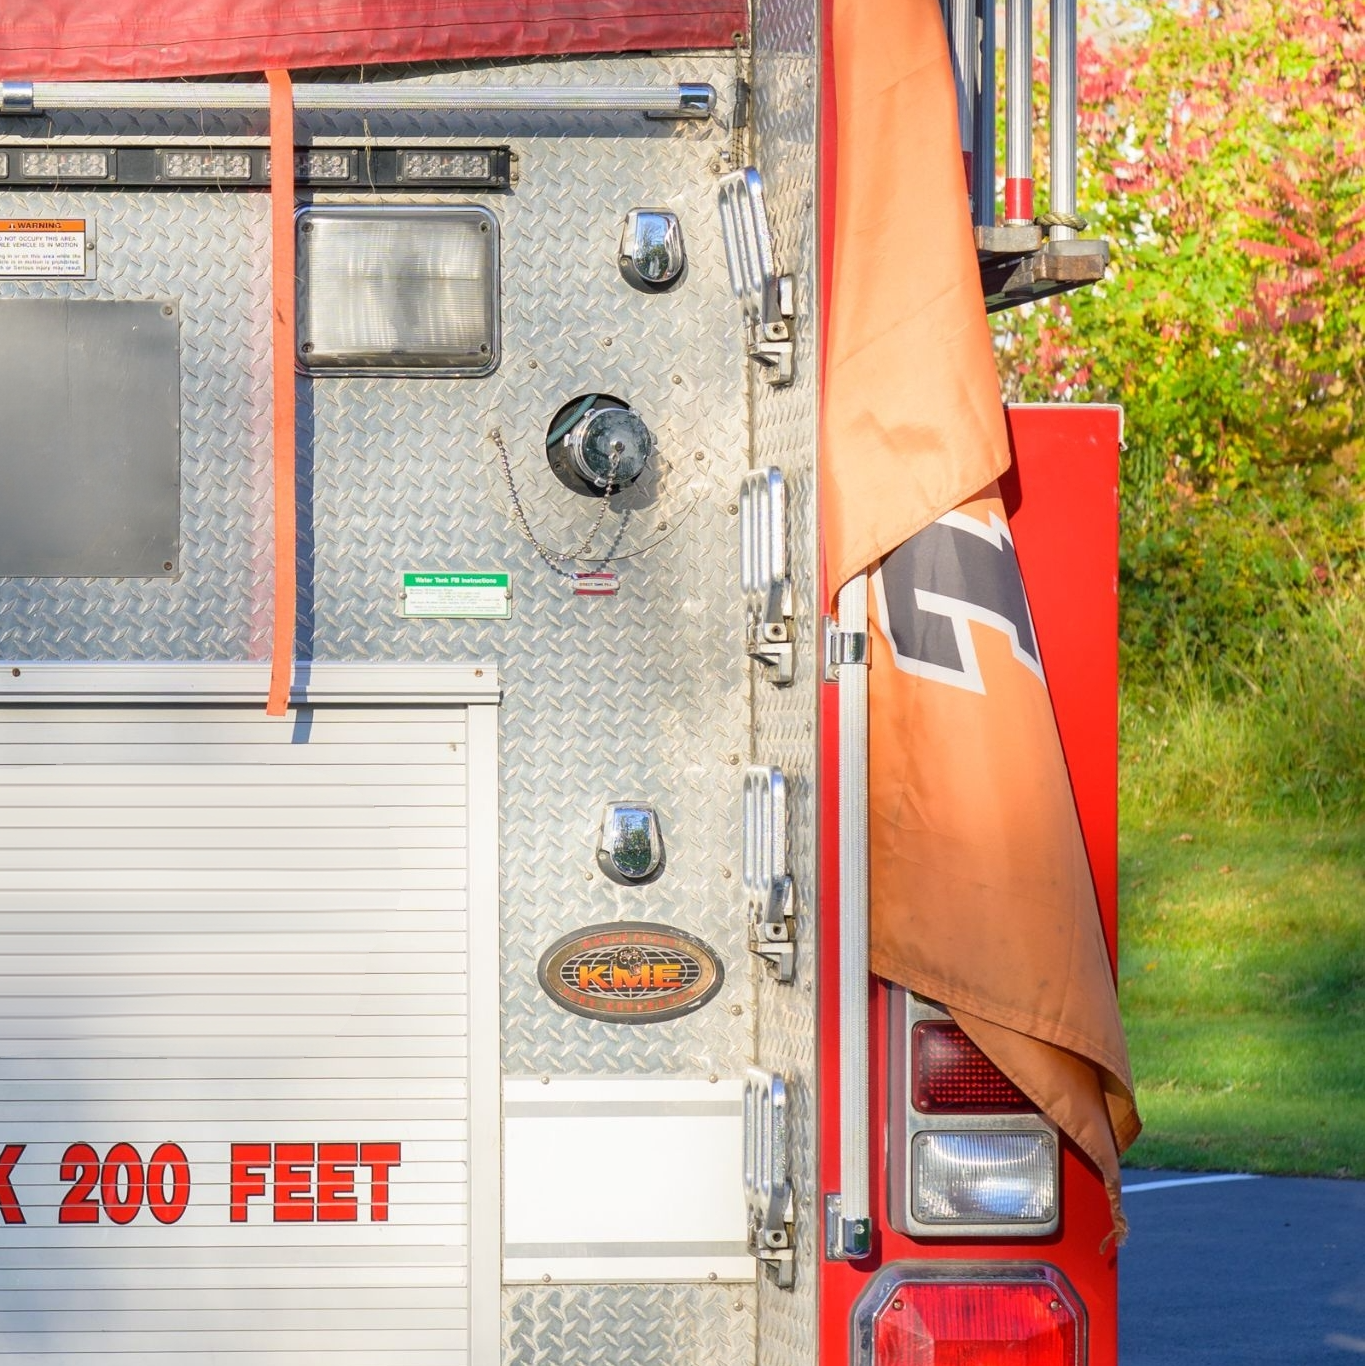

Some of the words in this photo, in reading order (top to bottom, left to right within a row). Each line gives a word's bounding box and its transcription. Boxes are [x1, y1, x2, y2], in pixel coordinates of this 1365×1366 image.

[578, 964, 682, 988] KME
[57, 1141, 192, 1225] 200
[229, 1142, 402, 1222] FEET
